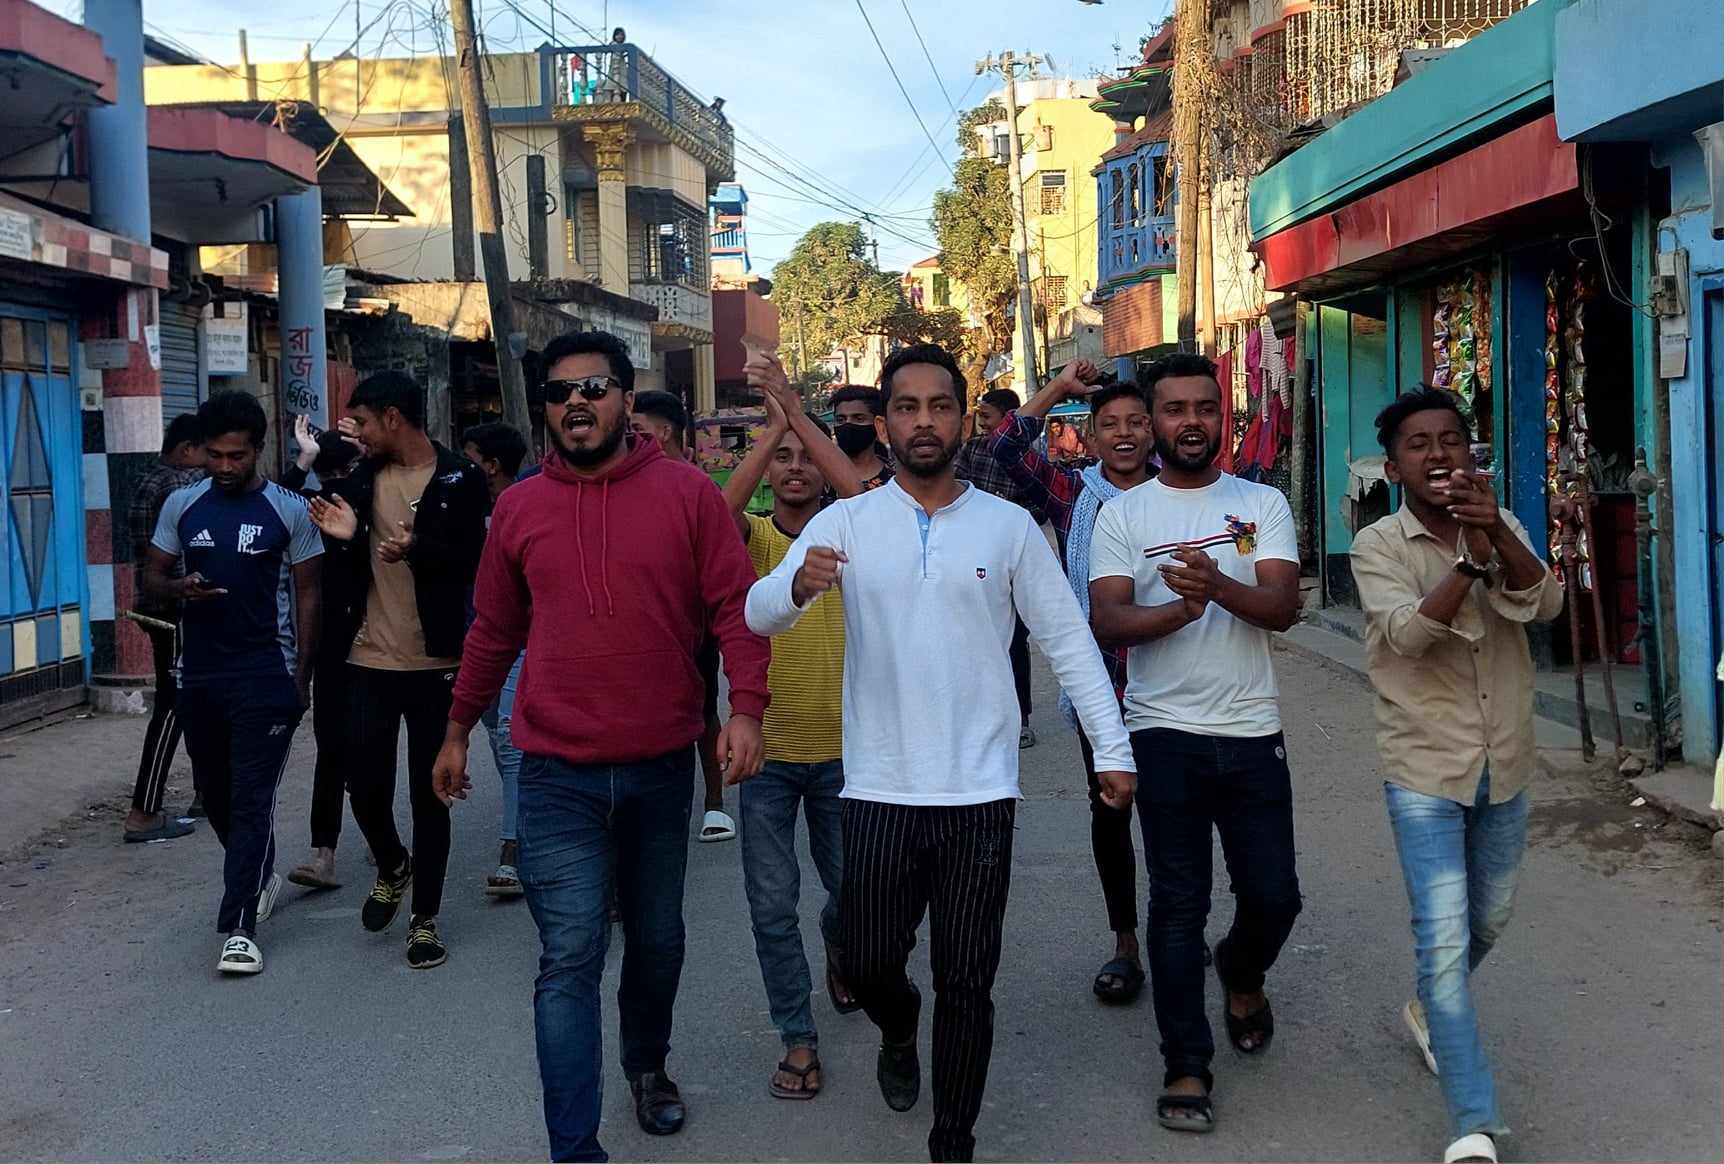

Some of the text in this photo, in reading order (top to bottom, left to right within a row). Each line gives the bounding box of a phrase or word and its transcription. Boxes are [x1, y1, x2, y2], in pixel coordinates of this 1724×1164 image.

[240, 524, 263, 536] JUST
[240, 533, 254, 544] DO
[225, 940, 249, 952] 23
